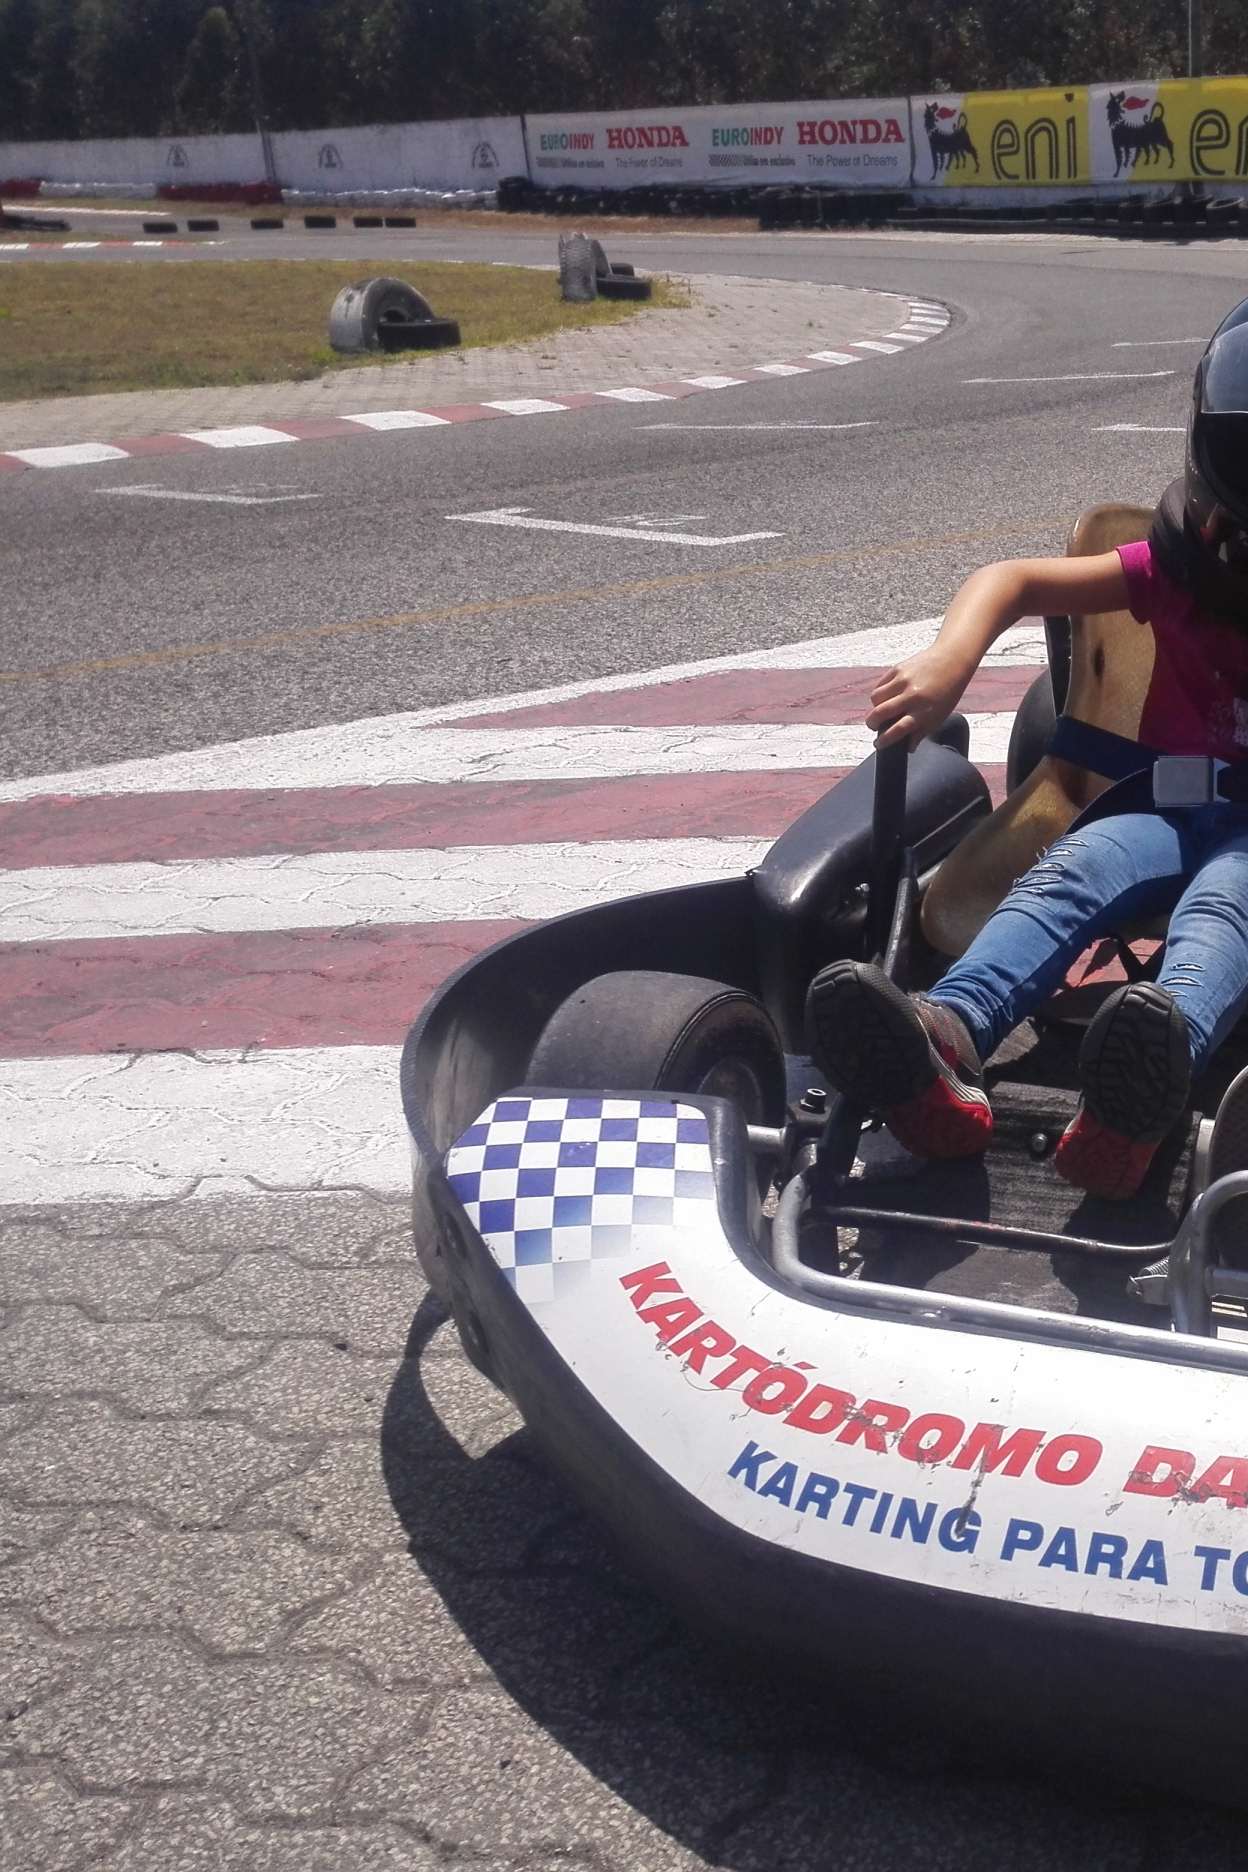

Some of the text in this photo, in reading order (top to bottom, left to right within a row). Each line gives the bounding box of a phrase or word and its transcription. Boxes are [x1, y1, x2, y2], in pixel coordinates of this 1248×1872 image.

[540, 133, 594, 151] EUROINDY
[606, 125, 690, 150] HONDA
[712, 126, 784, 147] EUROINDY
[797, 118, 906, 145] HONDA
[991, 92, 1077, 180] eni
[619, 1261, 1102, 1486] KARTÓDROMO
[727, 1440, 984, 1554] KARTING
[1000, 1518, 1169, 1585] PARA
